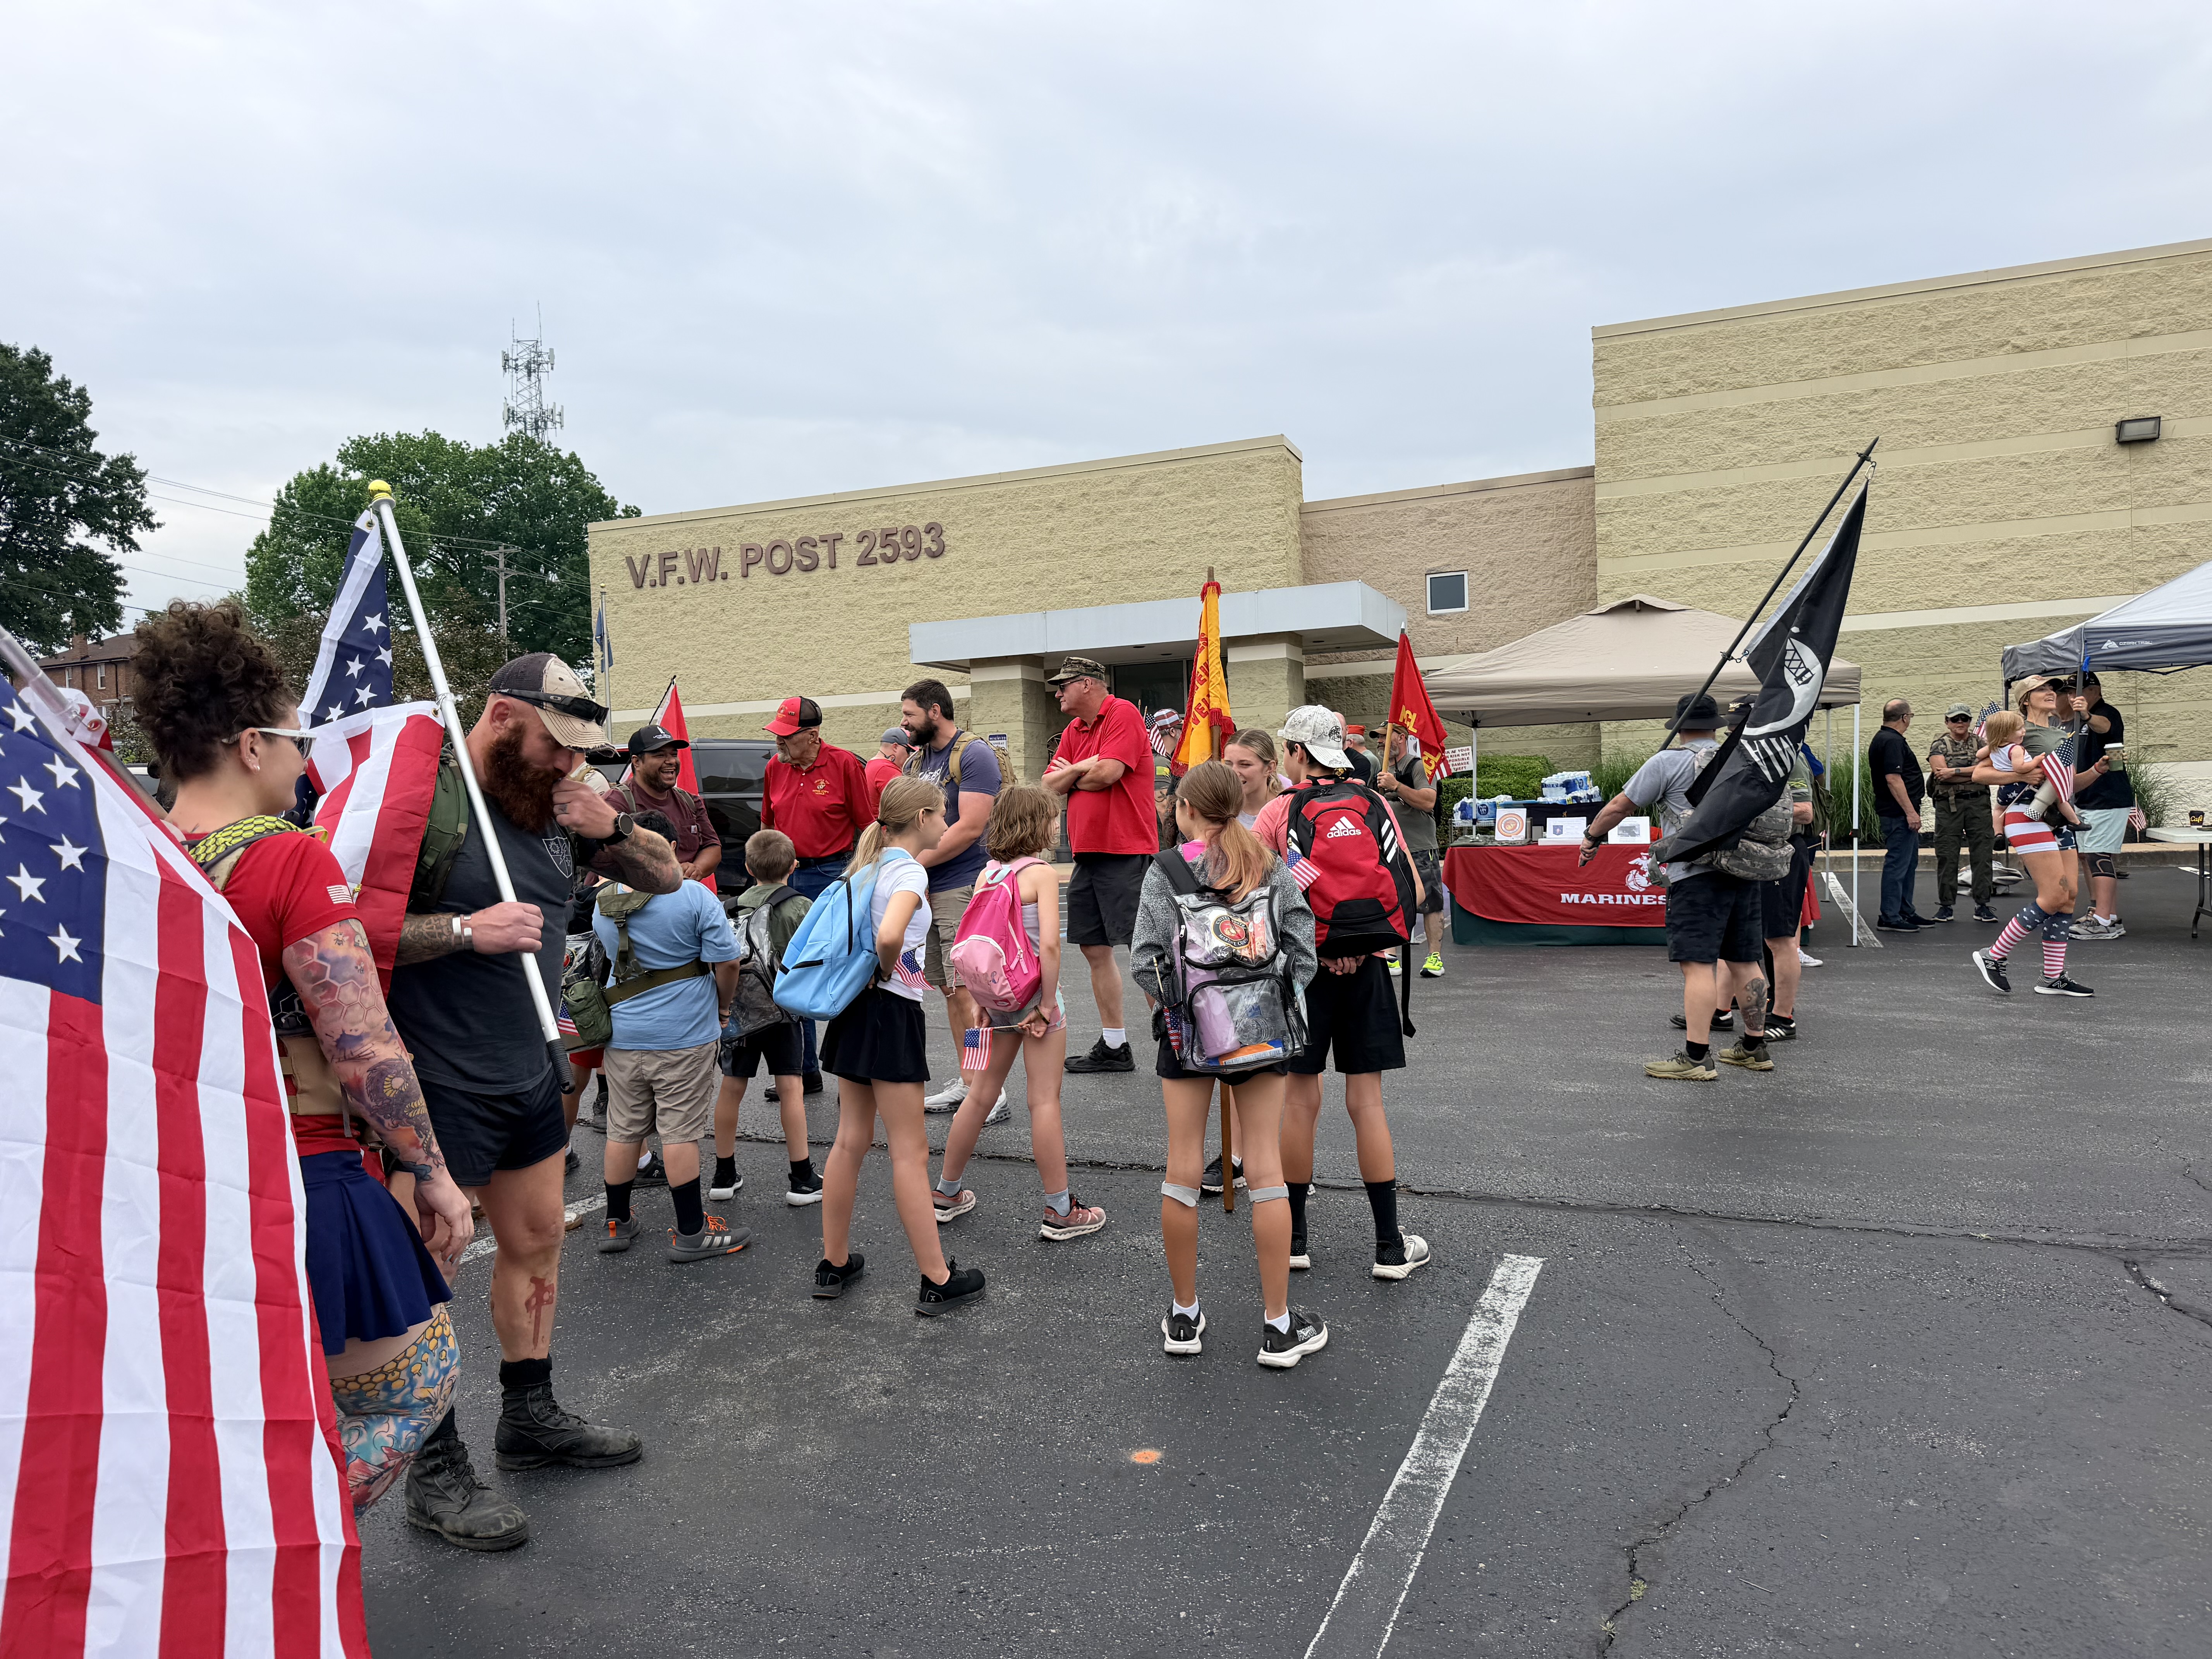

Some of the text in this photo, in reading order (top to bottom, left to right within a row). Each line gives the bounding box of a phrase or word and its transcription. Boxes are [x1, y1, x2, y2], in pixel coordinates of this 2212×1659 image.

[625, 522, 945, 588] V.F.W. POST 2593
[1740, 735, 1797, 783] MIA
[1327, 828, 1362, 838] adidas
[1560, 893, 1666, 905] MARINES
